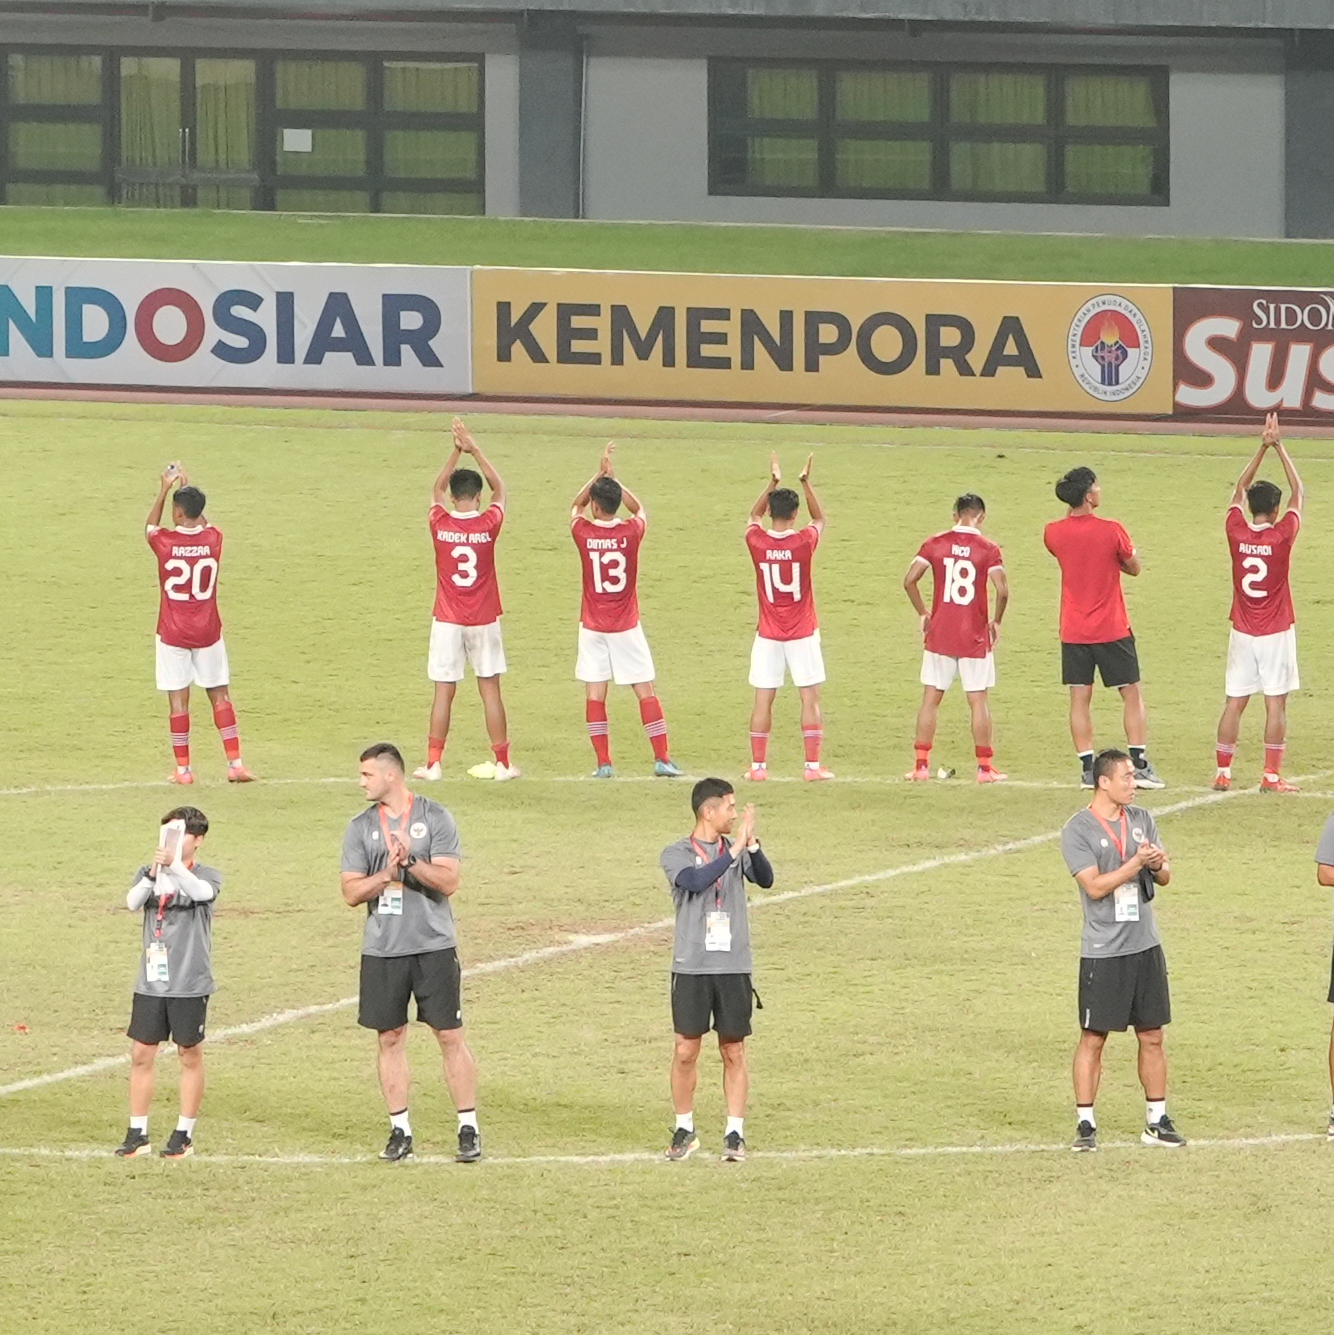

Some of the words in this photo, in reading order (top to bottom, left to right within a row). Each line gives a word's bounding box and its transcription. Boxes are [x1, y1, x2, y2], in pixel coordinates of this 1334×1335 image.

[495, 299, 1044, 381] KEMENPORA
[620, 536, 627, 549] J
[164, 557, 218, 601] 20
[450, 545, 479, 588] 3
[588, 551, 627, 594] 13
[758, 562, 802, 604] 14
[943, 557, 977, 606] 18
[1241, 556, 1269, 598] 2
